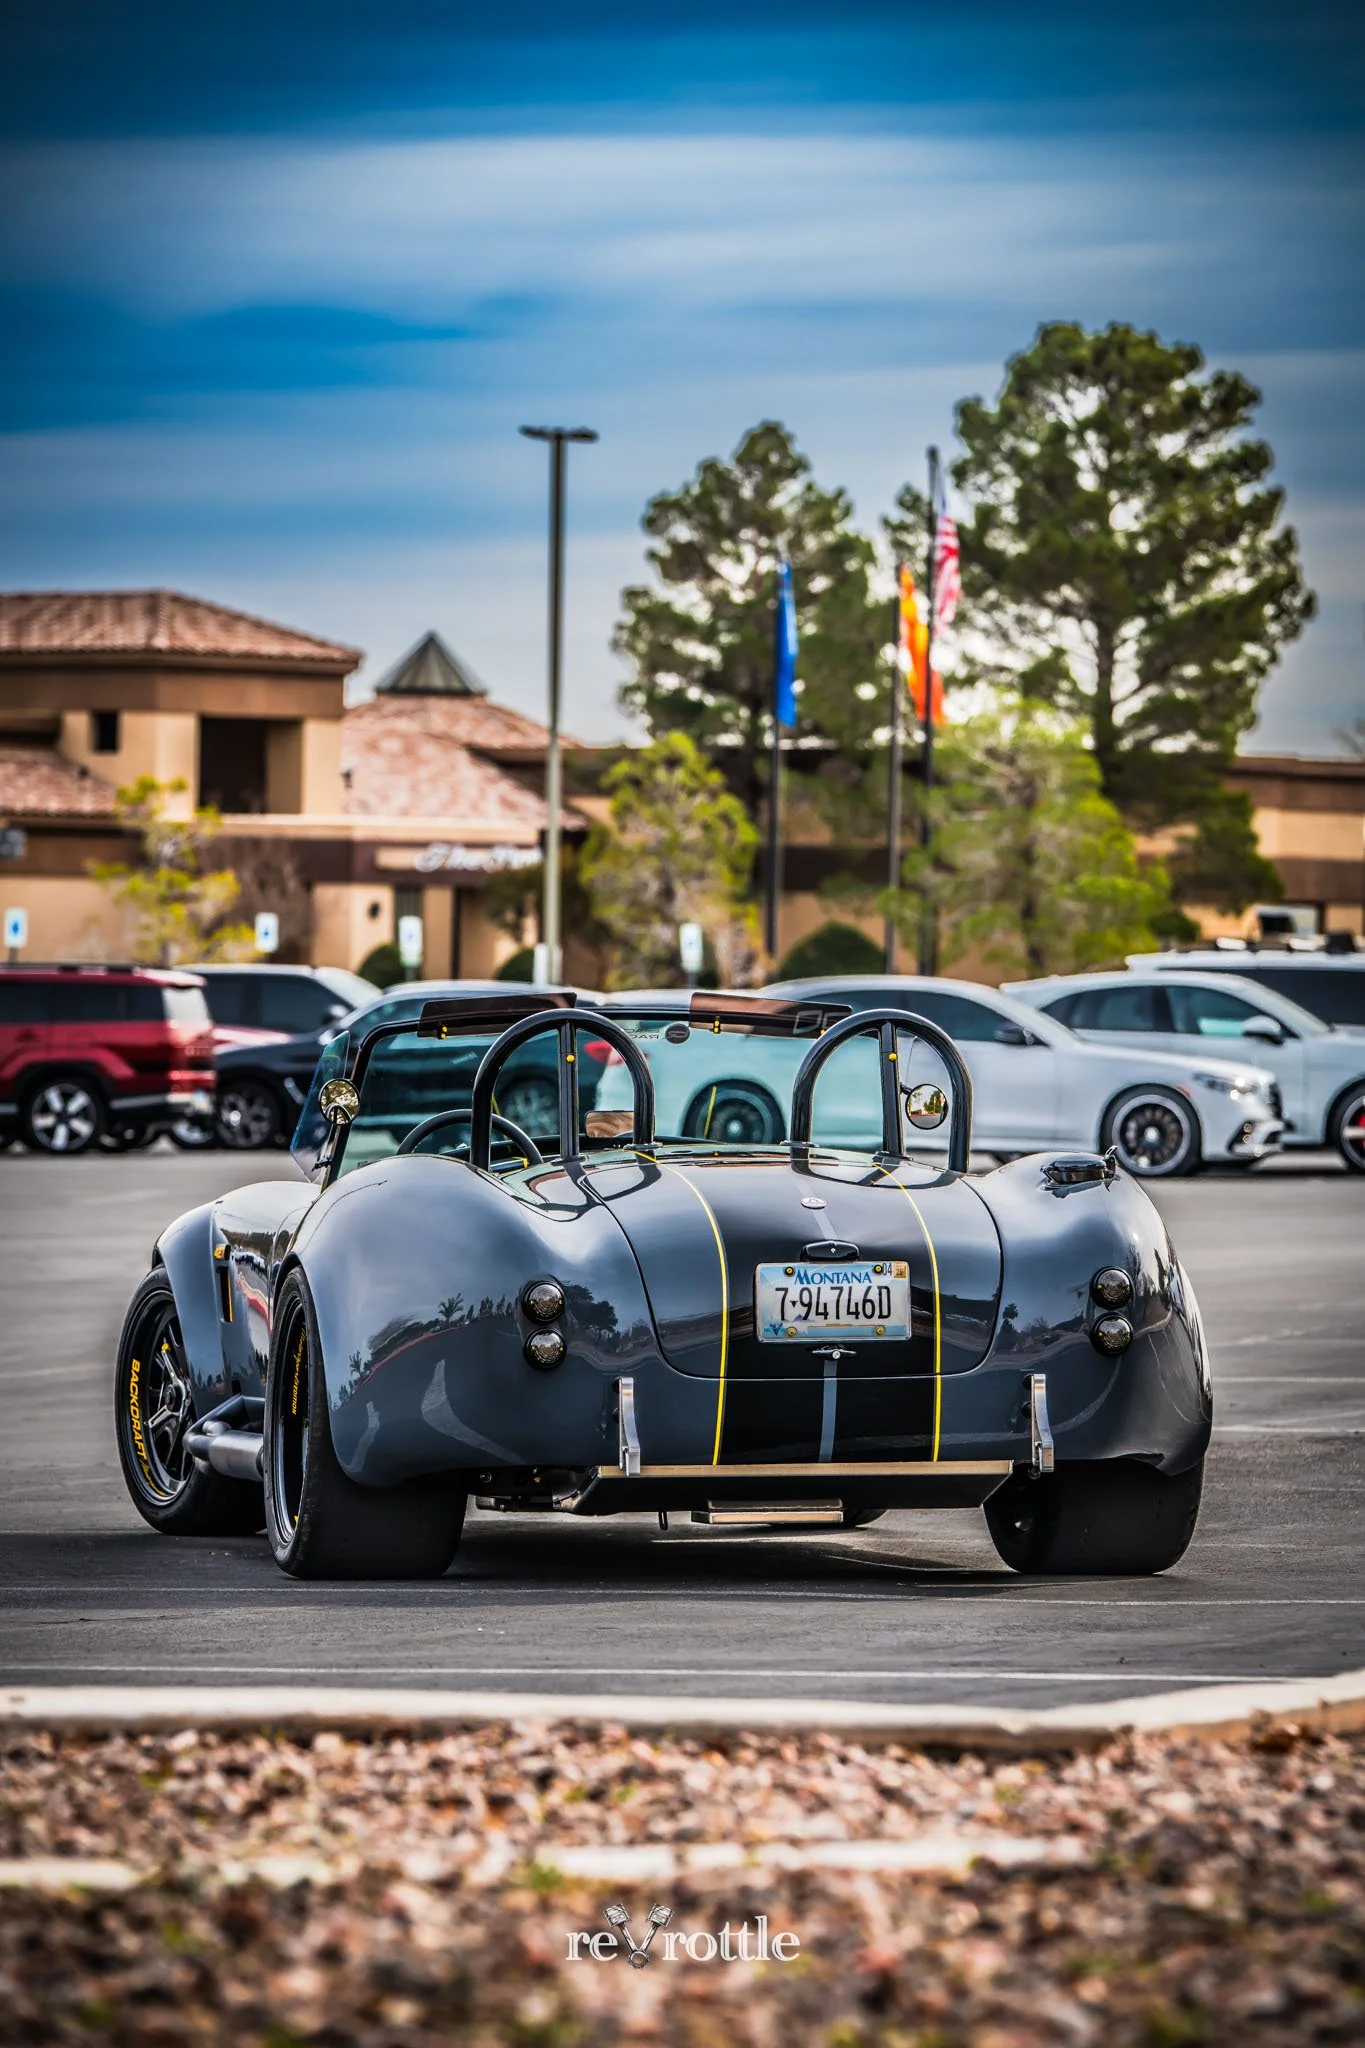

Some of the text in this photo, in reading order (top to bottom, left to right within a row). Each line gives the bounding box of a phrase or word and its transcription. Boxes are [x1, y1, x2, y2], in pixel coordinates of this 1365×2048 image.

[794, 1268, 872, 1285] MONTANA
[882, 1262, 893, 1276] 04
[129, 1358, 148, 1460] BACKDRAFT
[291, 1384, 299, 1415] EDITION
